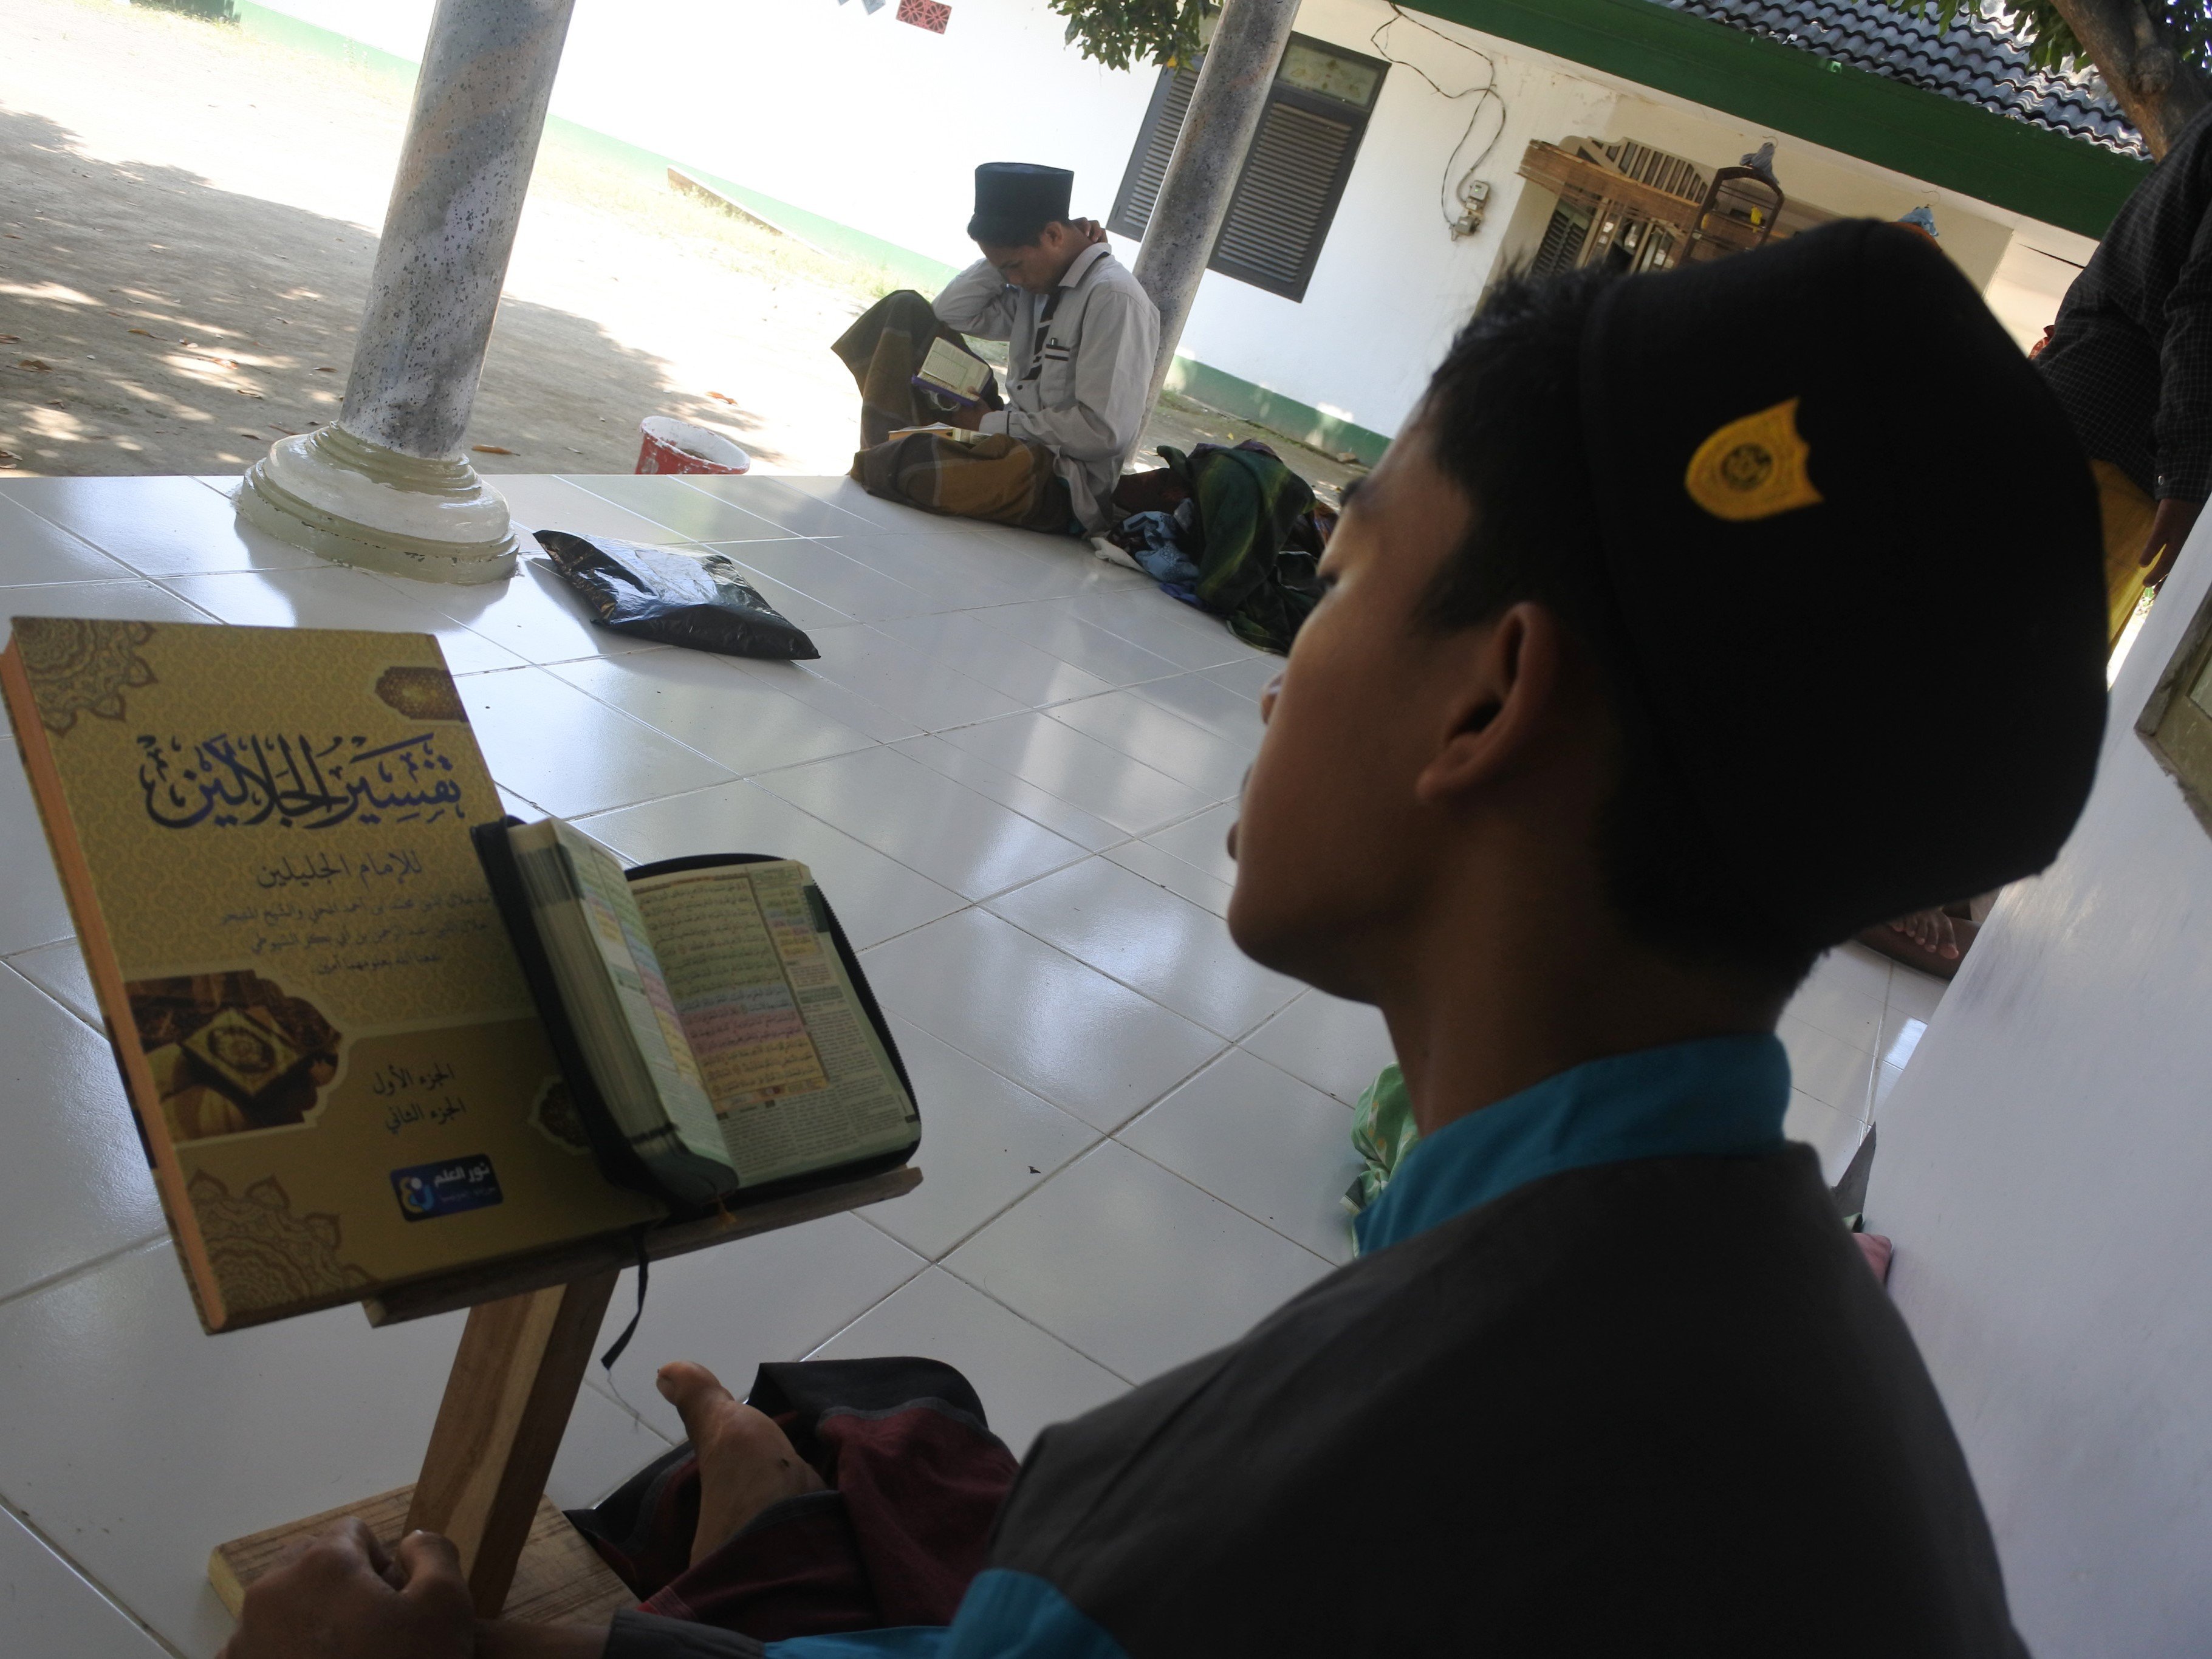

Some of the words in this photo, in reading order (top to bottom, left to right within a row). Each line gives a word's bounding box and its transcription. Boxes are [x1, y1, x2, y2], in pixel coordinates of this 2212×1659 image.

[256, 852, 351, 888] الجليلين
[372, 1064, 414, 1096] الأول
[419, 1062, 455, 1091] الجزء
[385, 1103, 425, 1135] الثاني
[430, 1096, 467, 1125] الجزء
[433, 1166, 466, 1188] العلم
[468, 1161, 490, 1183] نور
